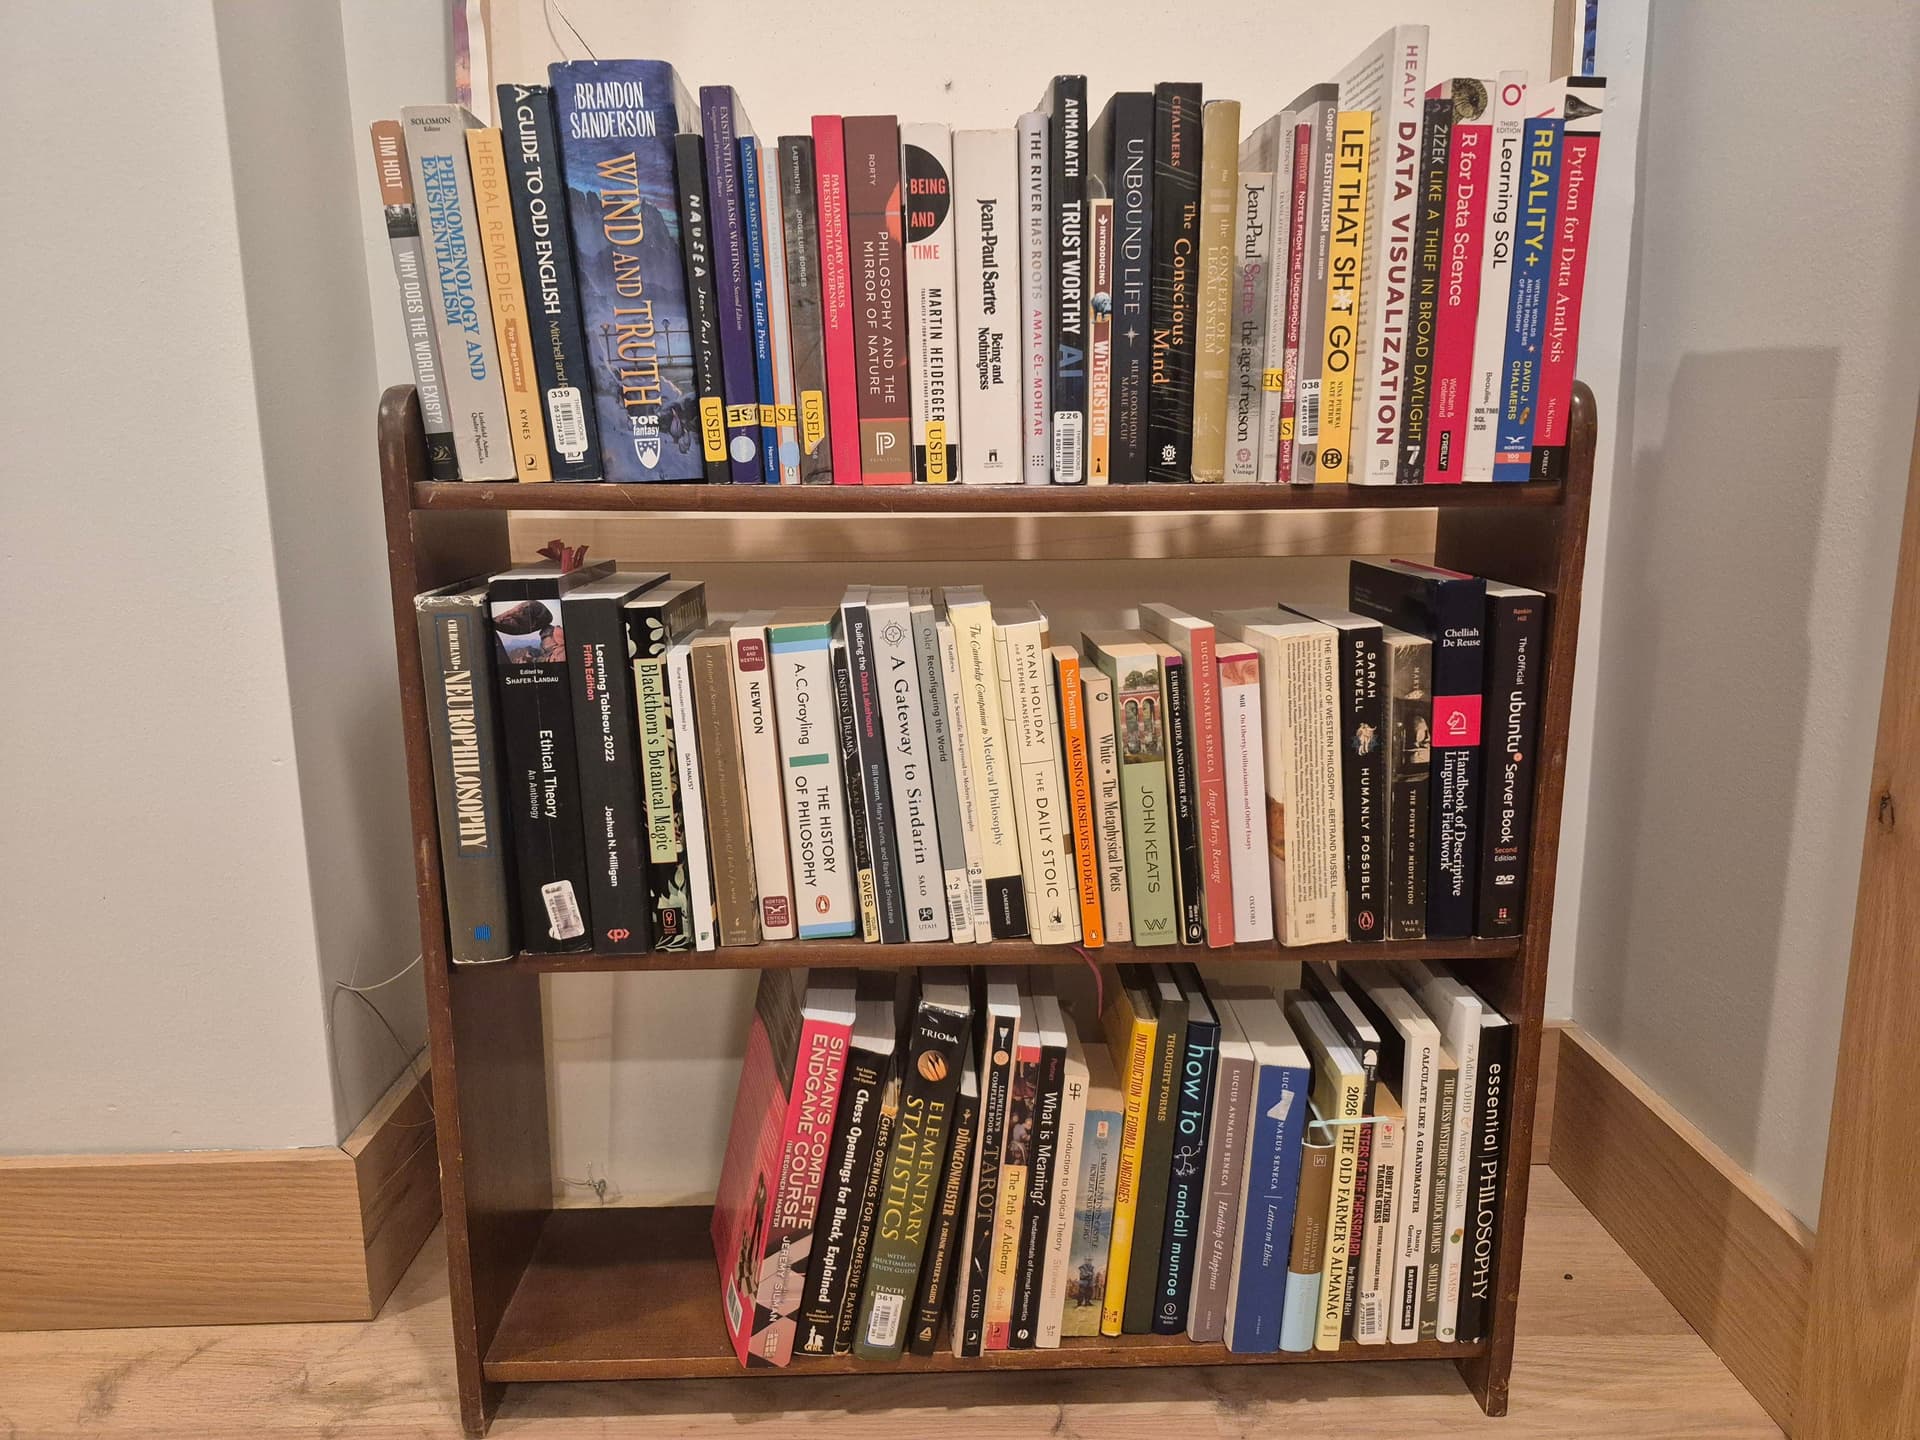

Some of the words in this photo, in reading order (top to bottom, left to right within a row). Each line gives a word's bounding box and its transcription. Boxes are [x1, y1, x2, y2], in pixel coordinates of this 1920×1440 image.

[514, 87, 530, 102] A
[575, 82, 644, 110] BRANDON
[1403, 45, 1418, 108] HEALY
[517, 106, 539, 163] GUIDE
[570, 109, 656, 139] SANDERSON
[1031, 130, 1041, 160] THE
[1064, 98, 1079, 177] AMMANATH
[1462, 133, 1478, 147] R
[525, 167, 544, 195] TO
[868, 154, 877, 186] RORTY
[1394, 122, 1416, 201] DATA
[1459, 152, 1477, 180] for
[1493, 138, 1517, 223] Learning
[1567, 146, 1587, 211] Python
[596, 152, 644, 246] WIND
[910, 178, 946, 195] BEING
[1031, 167, 1042, 212] RIVER
[1455, 185, 1473, 228] Data
[477, 141, 499, 213] HERBAL
[488, 221, 515, 313] REMEDIES
[530, 198, 549, 237] OLD
[823, 174, 834, 252] PRESIDENTIAL
[831, 174, 844, 263] PARLIAMENTARY
[911, 212, 935, 227] AND
[977, 198, 998, 270] Jean-Paul
[1031, 219, 1042, 246] HAS
[1563, 217, 1580, 243] for
[421, 156, 462, 325] EXISTENTIALISM
[911, 245, 940, 260] TIME
[1098, 226, 1107, 286] INTRODUCING
[1493, 230, 1510, 269] SQL
[436, 155, 480, 335] PHENOMENOLOGY
[466, 340, 486, 381] AND
[535, 240, 561, 314] ENGLISH
[612, 251, 643, 297] AND
[836, 266, 845, 308] VERSUS
[863, 241, 876, 303] MIRROR
[878, 232, 893, 330] PHILOSOPHY
[1031, 252, 1042, 299] ROOTS
[1061, 200, 1081, 334] TRUSTWORTHY
[1449, 233, 1469, 306] Science
[1558, 247, 1576, 286] Data
[827, 255, 838, 329] GOVERNMENT
[929, 288, 943, 340] MARTIN
[982, 271, 999, 316] Sartre
[866, 308, 878, 329] OF
[1032, 310, 1043, 348] AMAL
[1376, 213, 1410, 445] VISUALIZATION
[1550, 293, 1570, 363] Analysis
[613, 300, 662, 407] TRUTH
[867, 335, 881, 395] NATURE
[882, 337, 894, 369] AND
[977, 328, 990, 390] Nothingness
[1059, 344, 1083, 377] AI
[1153, 329, 1170, 384] Mind
[884, 375, 896, 404] THE
[930, 347, 945, 422] HEIDEGGER
[1033, 354, 1044, 436] EL-MOHTAR
[1439, 378, 1449, 418] Grolemund
[1508, 361, 1521, 420] CHALMERS
[520, 409, 531, 439] KYNES
[631, 416, 659, 424] TOR
[704, 406, 721, 451] USED
[1545, 398, 1556, 439] McKinney
[929, 428, 943, 475] USED
[583, 644, 593, 667] Fifth
[1442, 639, 1455, 648] De
[1456, 638, 1481, 648] Reuse
[1444, 628, 1480, 638] Chelliah
[595, 644, 606, 690] Learning
[890, 656, 905, 671] A
[1025, 643, 1038, 679] RYAN
[1201, 641, 1210, 677] LUCIUS
[1354, 641, 1364, 712] BAKEWELL
[1367, 652, 1376, 698] SARAH
[585, 668, 595, 701] Edition
[640, 663, 664, 745] Blackthorn's
[1203, 683, 1212, 730] ANNAEUS
[600, 693, 611, 734] Tableau
[750, 681, 764, 734] NEWTON
[894, 679, 913, 756] Gateway
[1030, 686, 1045, 744] HOLIDAY
[443, 670, 488, 848] NEUROPHILOSOPHY
[540, 730, 557, 773] Ethical
[604, 735, 615, 762] 2022
[1100, 734, 1113, 764] White
[1206, 734, 1217, 773] SENECA
[648, 750, 671, 810] Botanical
[795, 776, 809, 795] OF
[904, 763, 917, 781] to
[1034, 771, 1045, 792] THE
[1102, 779, 1116, 798] The
[1440, 751, 1457, 809] Linguistic
[544, 777, 558, 819] Theory
[817, 785, 831, 811] THE
[1036, 798, 1053, 843] DAILY
[1141, 786, 1155, 834] JOHN
[1361, 768, 1370, 830] HUMANLY
[604, 806, 616, 838] Joshua
[650, 815, 673, 850] Magic
[797, 801, 817, 887] PHILOSOPHY
[820, 816, 836, 873] HISTORY
[906, 788, 927, 864] Sindarin
[1103, 800, 1121, 864] Metaphysical
[1440, 812, 1455, 870] Fieldwork
[608, 839, 617, 851] N.
[1145, 840, 1160, 894] KEATS
[1361, 835, 1370, 900] POSSIBLE
[608, 851, 618, 887] Milligan
[918, 875, 927, 896] SALO
[1042, 850, 1058, 898] STOIC
[1109, 866, 1123, 892] Poets
[920, 1027, 959, 1045] TRIOLA
[1163, 1033, 1176, 1084] THOUGHT
[797, 1034, 828, 1134] ENDGAME
[817, 1036, 843, 1125] SILMAN'S
[1183, 1044, 1214, 1100] how
[1231, 1070, 1240, 1103] LUCIUS
[1419, 1047, 1430, 1103] CALCULATE
[852, 1089, 869, 1123] Chess
[1157, 1085, 1169, 1121] FORMS
[1180, 1110, 1201, 1134] to
[1345, 1086, 1360, 1116] 2026
[1418, 1105, 1426, 1129] LIKE
[1484, 1063, 1501, 1152] essential
[1225, 1106, 1237, 1150] ANNAEUS
[1341, 1127, 1356, 1155] THE
[1417, 1130, 1424, 1138] A
[839, 1126, 862, 1183] Openings
[881, 1095, 924, 1241] STATISTICS
[905, 1102, 945, 1245] ELEMENTARY
[1221, 1152, 1232, 1187] SENECA
[1339, 1157, 1353, 1184] OLD
[1412, 1140, 1424, 1213] GRANDMASTER
[781, 1141, 809, 1228] COURSE
[798, 1131, 827, 1230] COMPLETE
[838, 1185, 852, 1203] for
[1375, 1164, 1385, 1198] TEACHES
[1384, 1165, 1394, 1190] BOBBY
[828, 1207, 847, 1242] Black,
[1174, 1184, 1190, 1237] randall
[1332, 1188, 1350, 1253] FARMER'S
[1374, 1200, 1382, 1224] CHESS
[1382, 1191, 1392, 1223] FISCHER
[1471, 1160, 1498, 1300] PHILOSOPHY
[818, 1244, 840, 1303] Explained
[1167, 1242, 1182, 1297] munroe
[1326, 1257, 1344, 1320] ALMANAC
[971, 1288, 981, 1319] LOUIS
